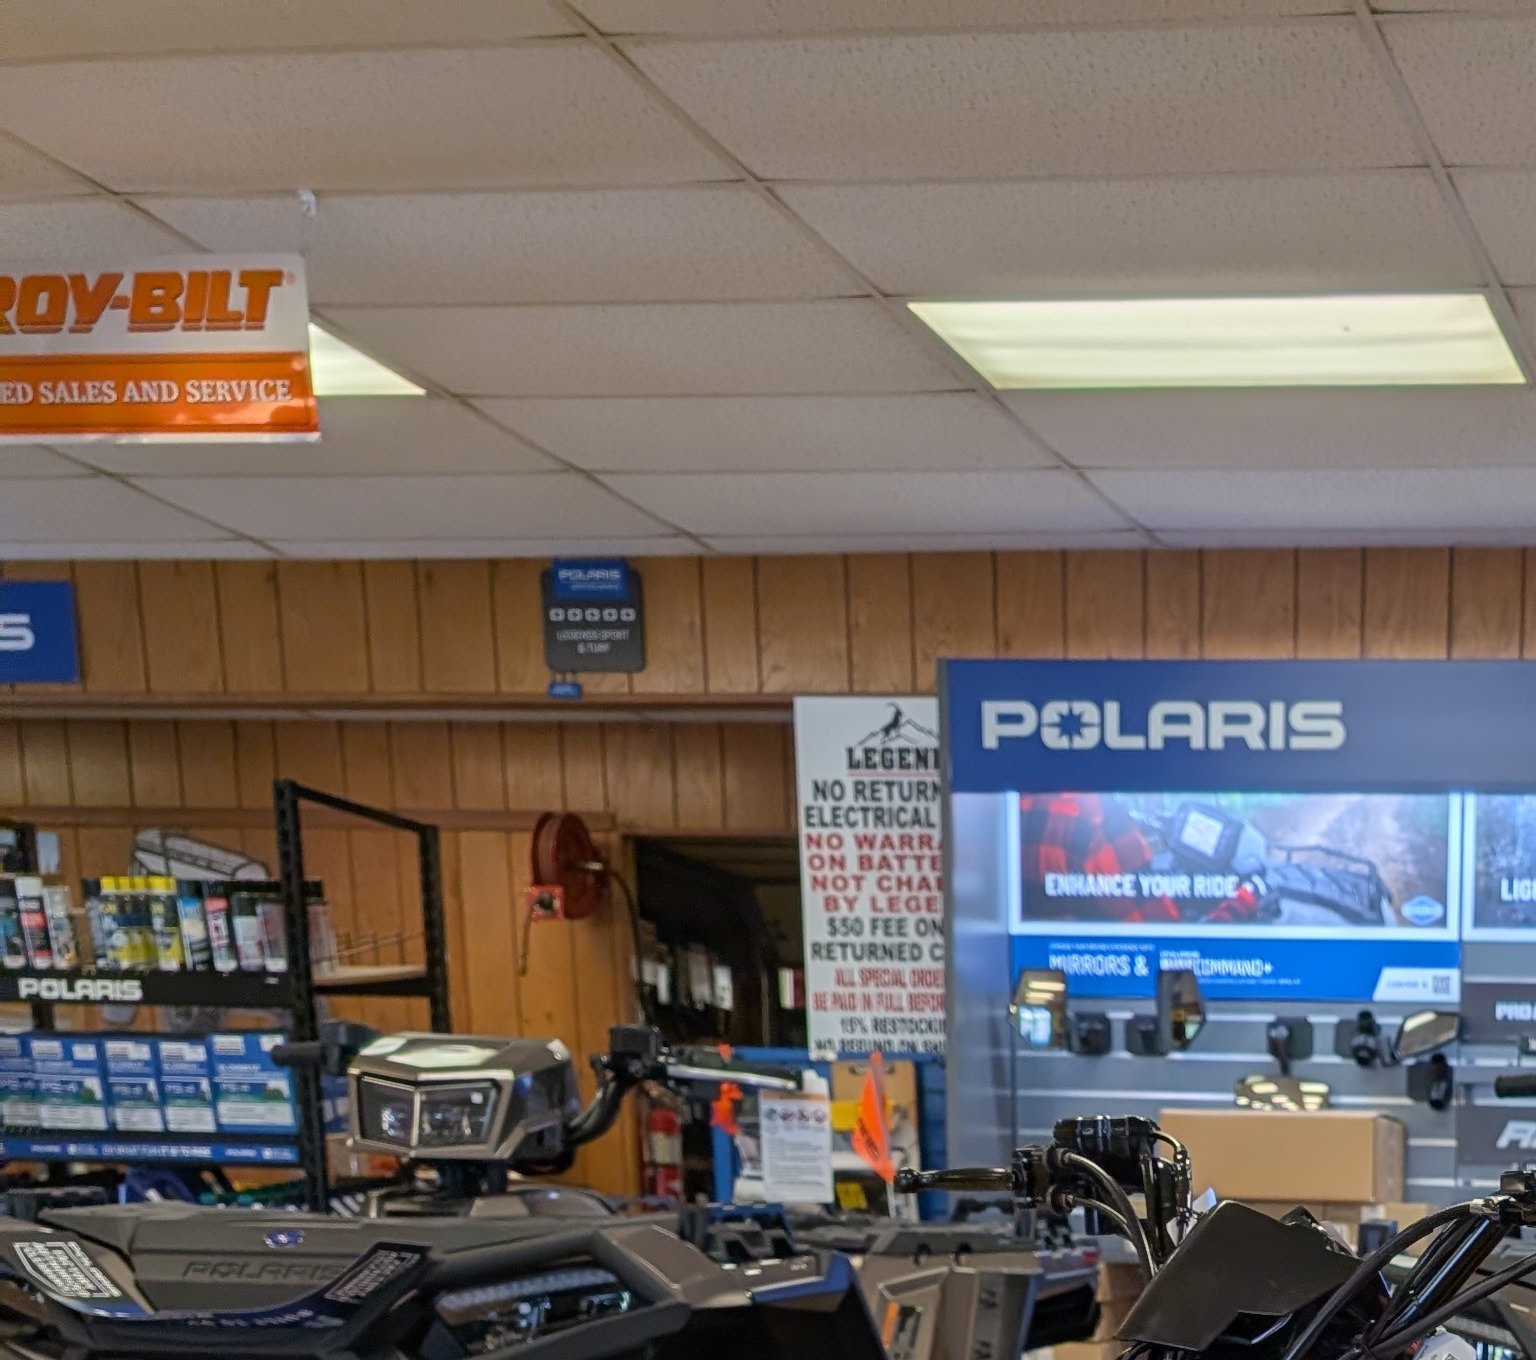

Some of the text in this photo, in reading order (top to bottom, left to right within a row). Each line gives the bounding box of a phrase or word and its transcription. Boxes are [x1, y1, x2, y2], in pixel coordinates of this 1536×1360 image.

[38, 380, 118, 404] SALES
[123, 380, 179, 403] AND
[186, 379, 292, 403] SERVICE
[981, 700, 1346, 750] POLARIS
[813, 780, 845, 802] NO
[805, 806, 936, 829] ELECTRICAL
[806, 833, 943, 850] NO WARR
[808, 854, 845, 871] ON
[811, 875, 864, 891] NOT
[1045, 873, 1239, 898] ENHANCE YOUR RIDE
[824, 895, 858, 913] BY
[827, 917, 864, 936] $50
[870, 917, 907, 936] FEE
[811, 943, 922, 960] RETURNED
[1049, 954, 1149, 976] MIRRORS &
[858, 967, 906, 988] SPECIAL
[18, 979, 143, 1000] POLARIS
[183, 1259, 345, 1281] POLARIS
